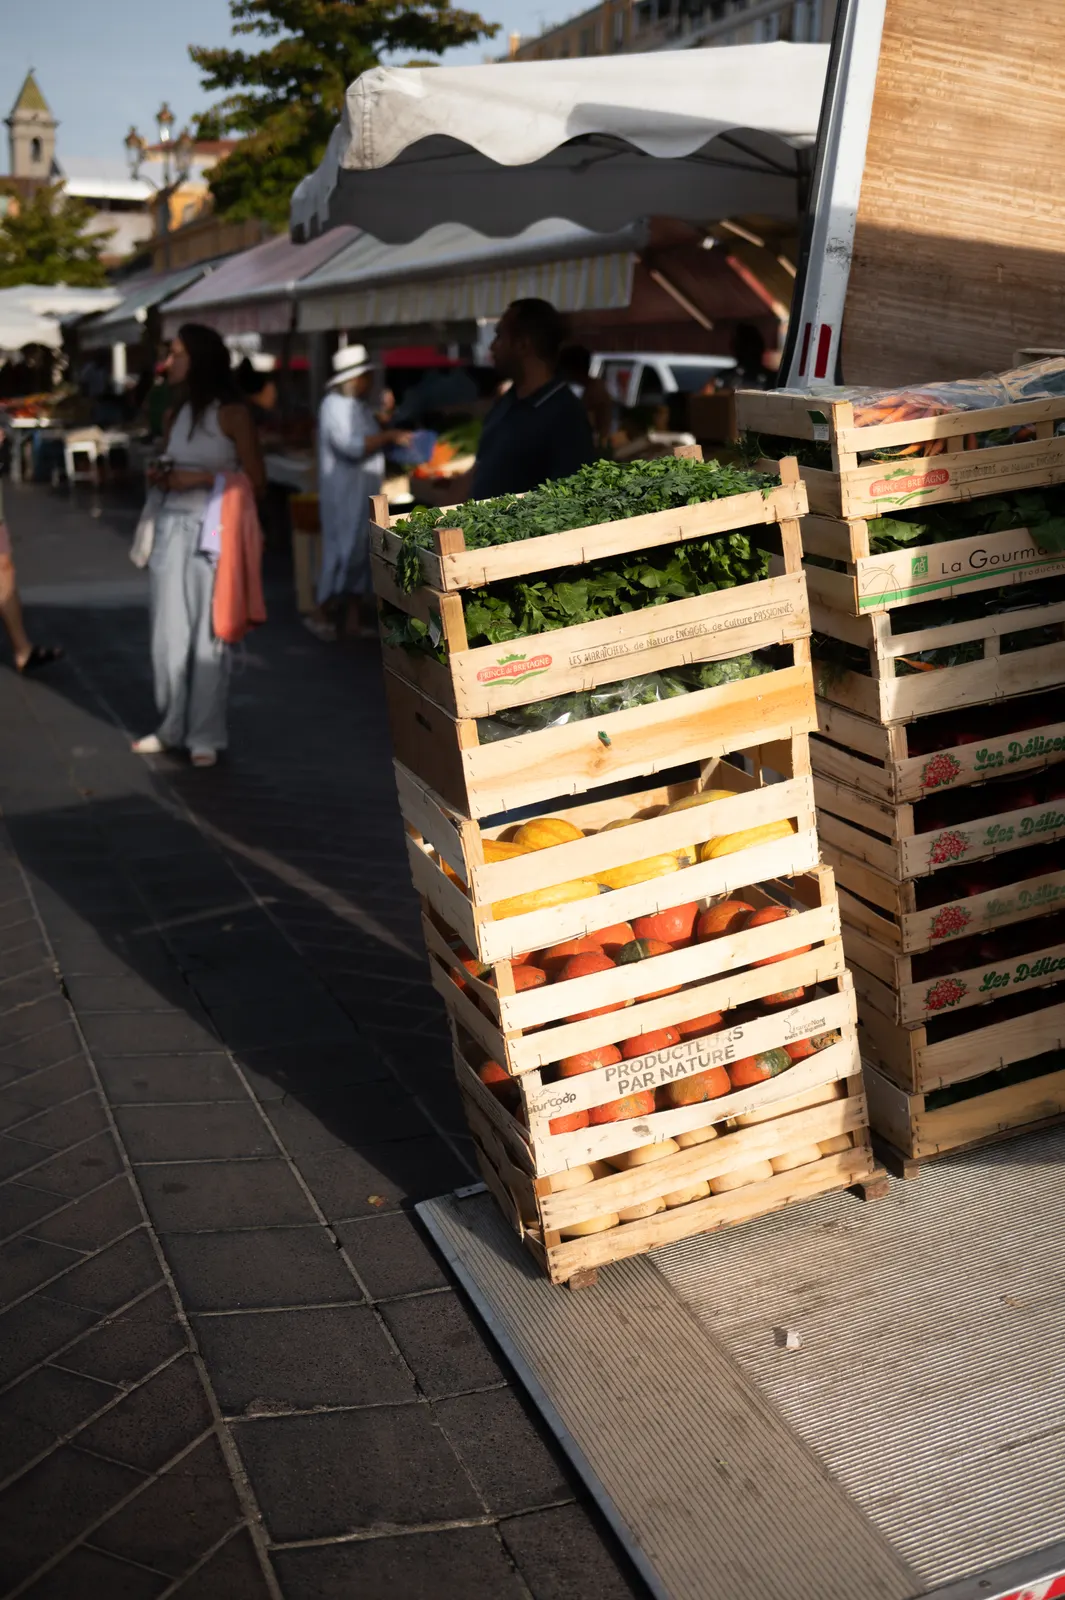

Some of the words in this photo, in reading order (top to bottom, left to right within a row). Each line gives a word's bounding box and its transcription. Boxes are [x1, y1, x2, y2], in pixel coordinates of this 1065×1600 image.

[872, 482, 898, 494] PRINCE
[907, 474, 946, 488] BRETAGNE
[942, 562, 961, 575] La
[969, 547, 1049, 569] Gourma
[568, 655, 582, 666] LES
[633, 641, 644, 650] de
[646, 634, 675, 647] Nature
[712, 622, 722, 631] de
[724, 615, 753, 628] Culture
[753, 602, 795, 621] PASSIONNÉS
[480, 668, 505, 680] PRINCE
[513, 657, 550, 672] BRETAGNE
[973, 748, 1004, 771] Les
[983, 823, 1015, 846] Les
[1017, 811, 1065, 838] Délic
[978, 971, 1011, 992] Les
[604, 1026, 744, 1082] PRODUCTEURS
[617, 1071, 656, 1095] PAR
[659, 1044, 736, 1082] NATURE
[527, 1091, 577, 1115] atur'Coop
